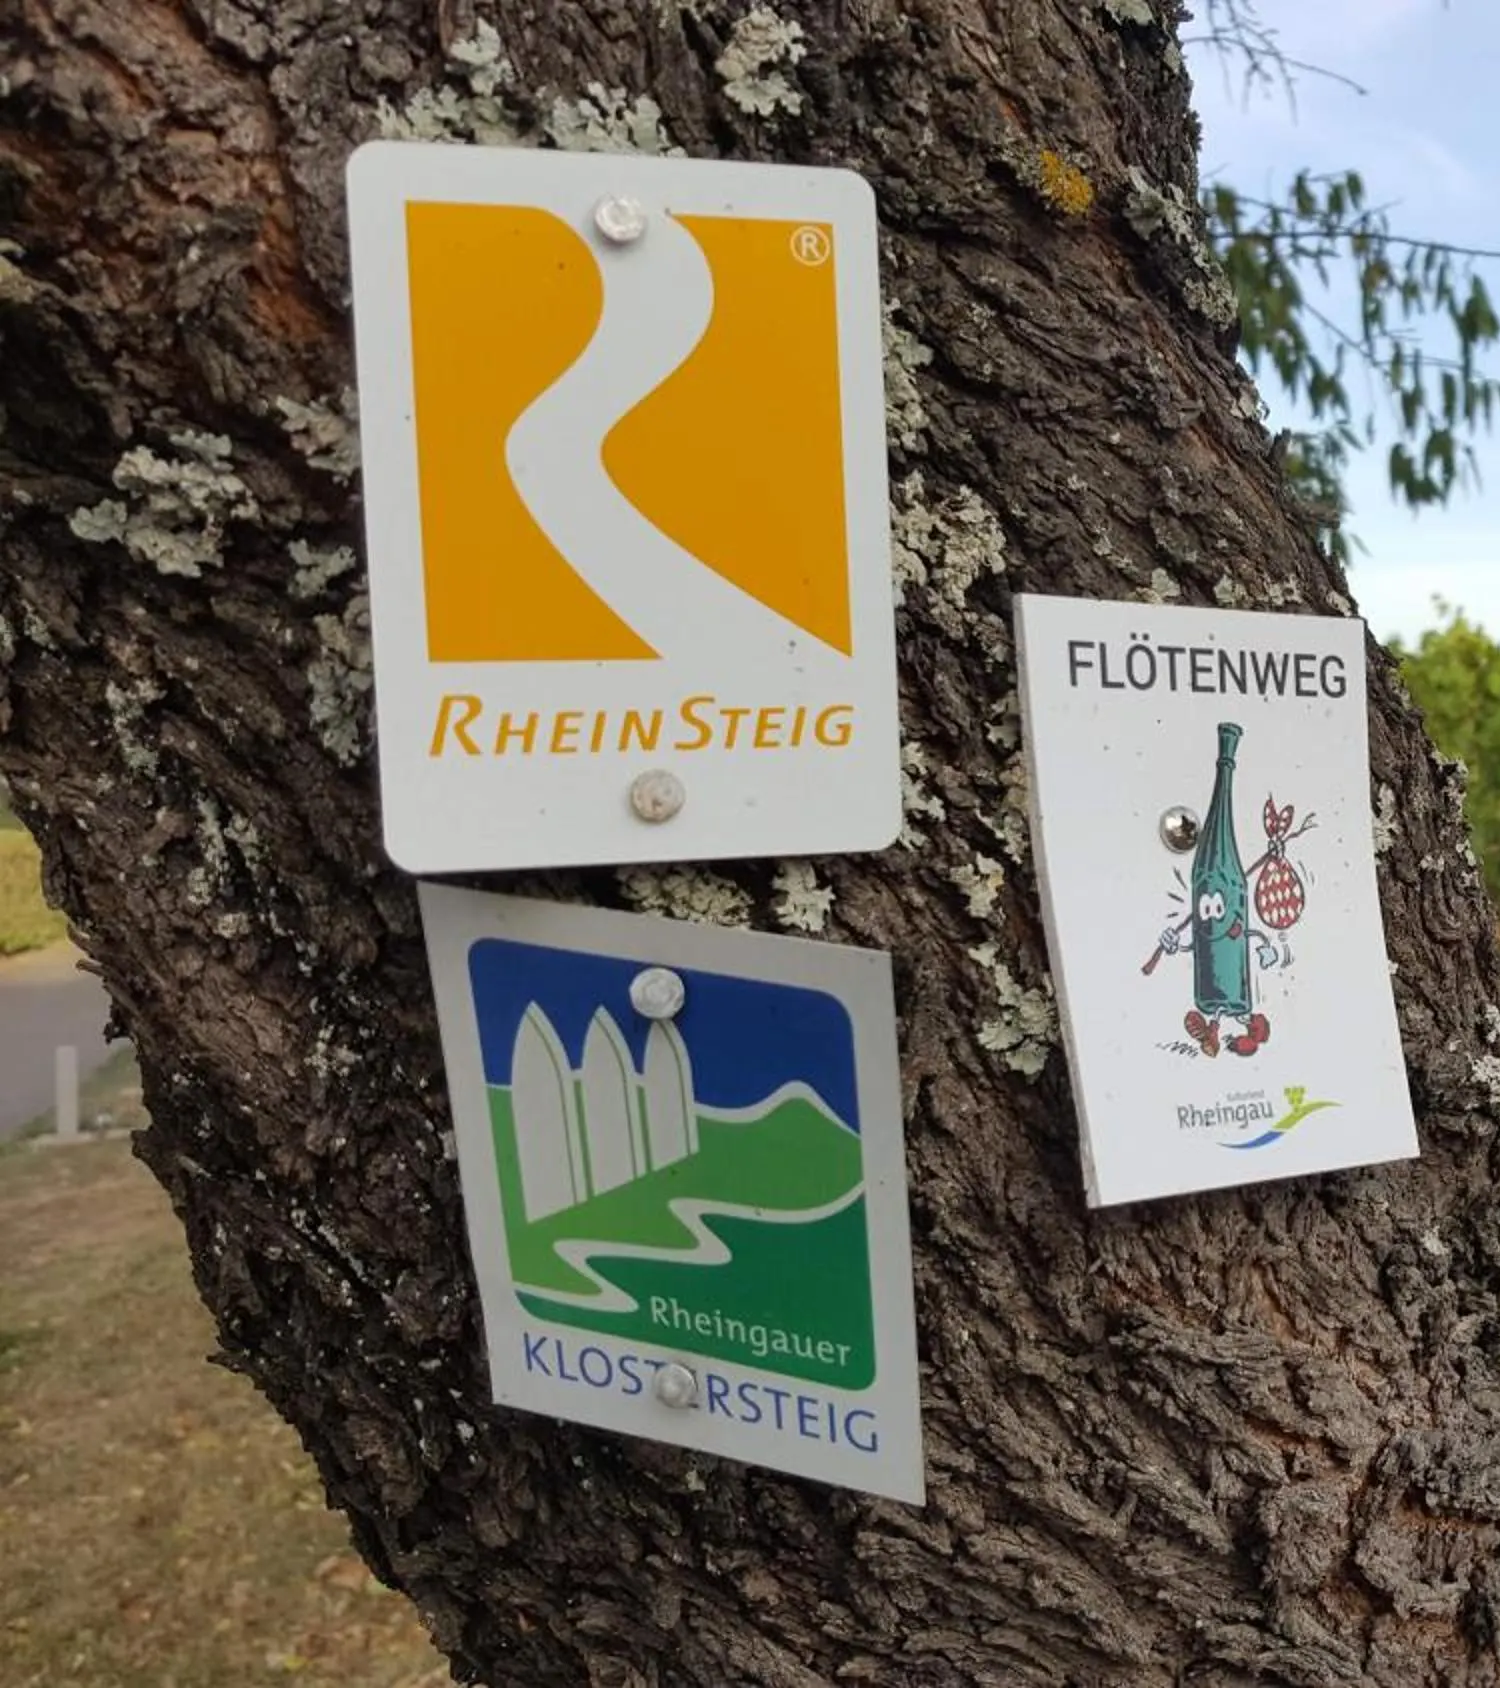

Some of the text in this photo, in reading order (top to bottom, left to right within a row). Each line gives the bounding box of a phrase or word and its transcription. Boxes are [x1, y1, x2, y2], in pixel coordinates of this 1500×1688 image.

[1068, 632, 1347, 698] FLÖTENWEG
[1177, 1101, 1274, 1129] Rheingau
[650, 1295, 852, 1367] Rheingauer
[522, 1331, 879, 1453] KLOSTRSTEIG
